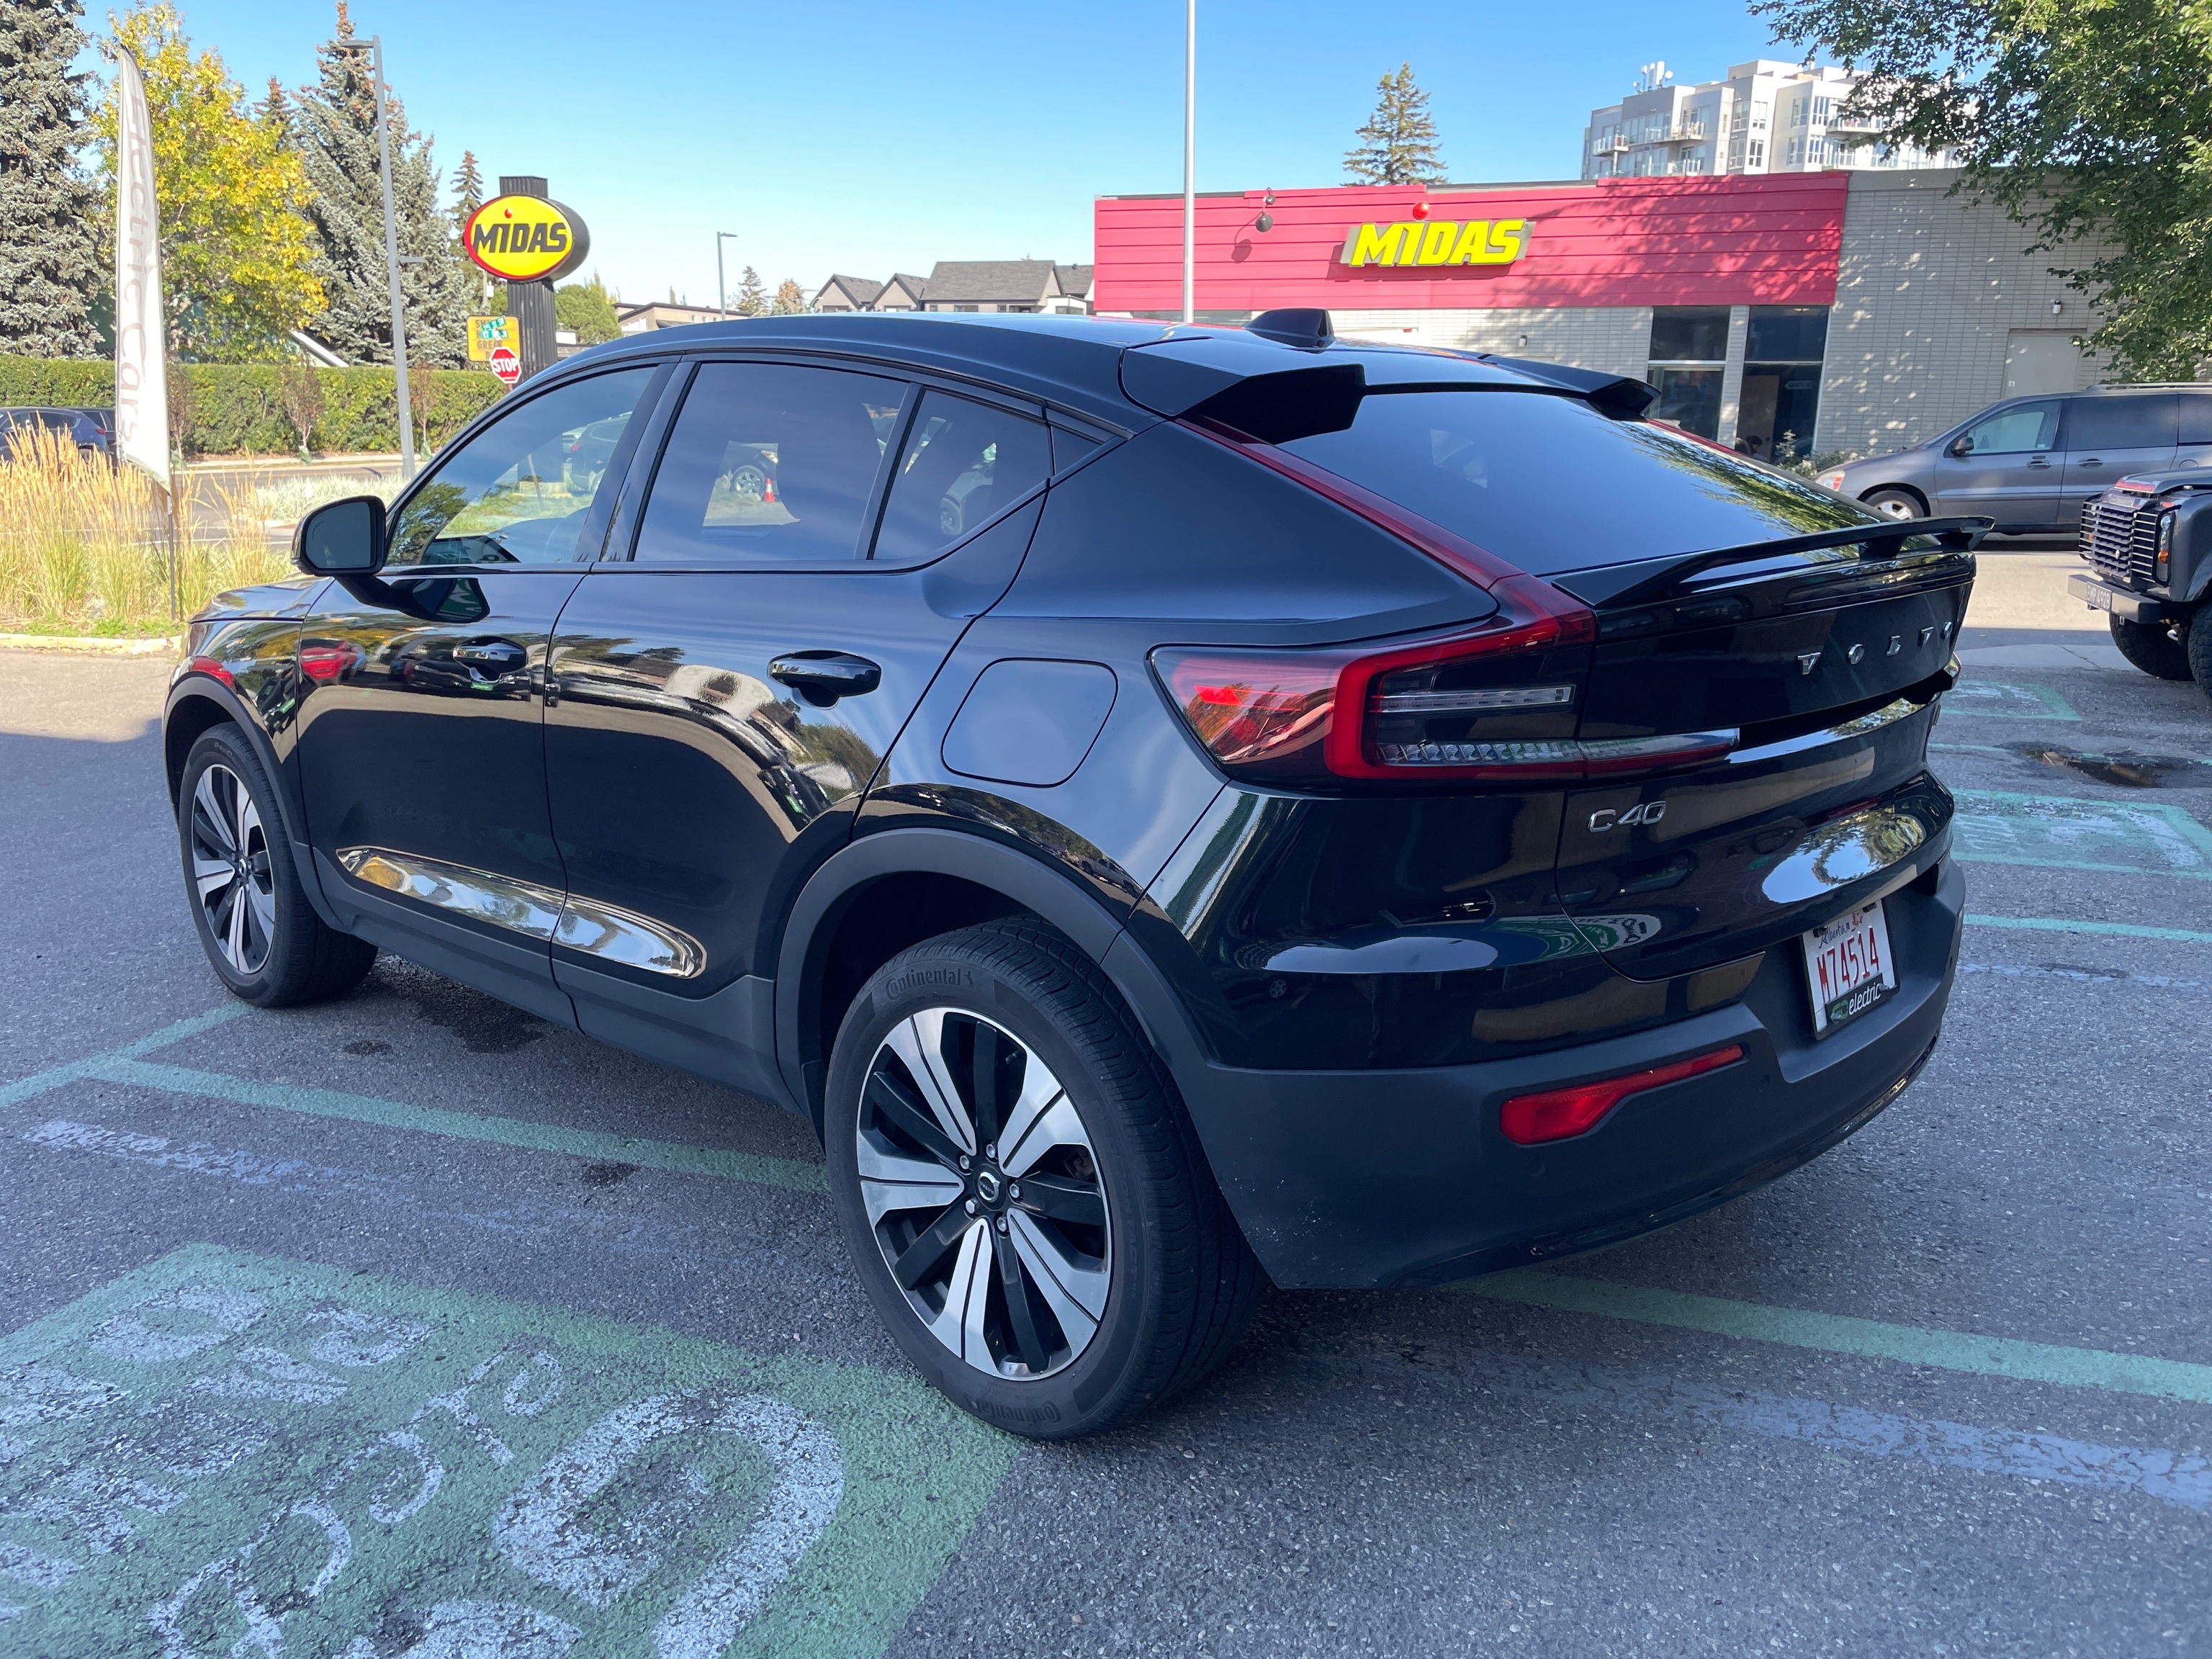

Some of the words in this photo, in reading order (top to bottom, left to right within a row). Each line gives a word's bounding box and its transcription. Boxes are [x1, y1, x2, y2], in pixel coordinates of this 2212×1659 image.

[473, 221, 567, 254] MIDAS
[1349, 218, 1518, 266] MIDAS
[120, 322, 146, 442] Cars
[492, 357, 518, 373] STOP
[1797, 621, 1953, 675] VOLVO
[1588, 801, 1667, 833] C40
[1816, 926, 1880, 1005] M74514
[885, 968, 961, 1001] Continental
[1848, 981, 1881, 1016] electric
[975, 1398, 1062, 1426] Continental
